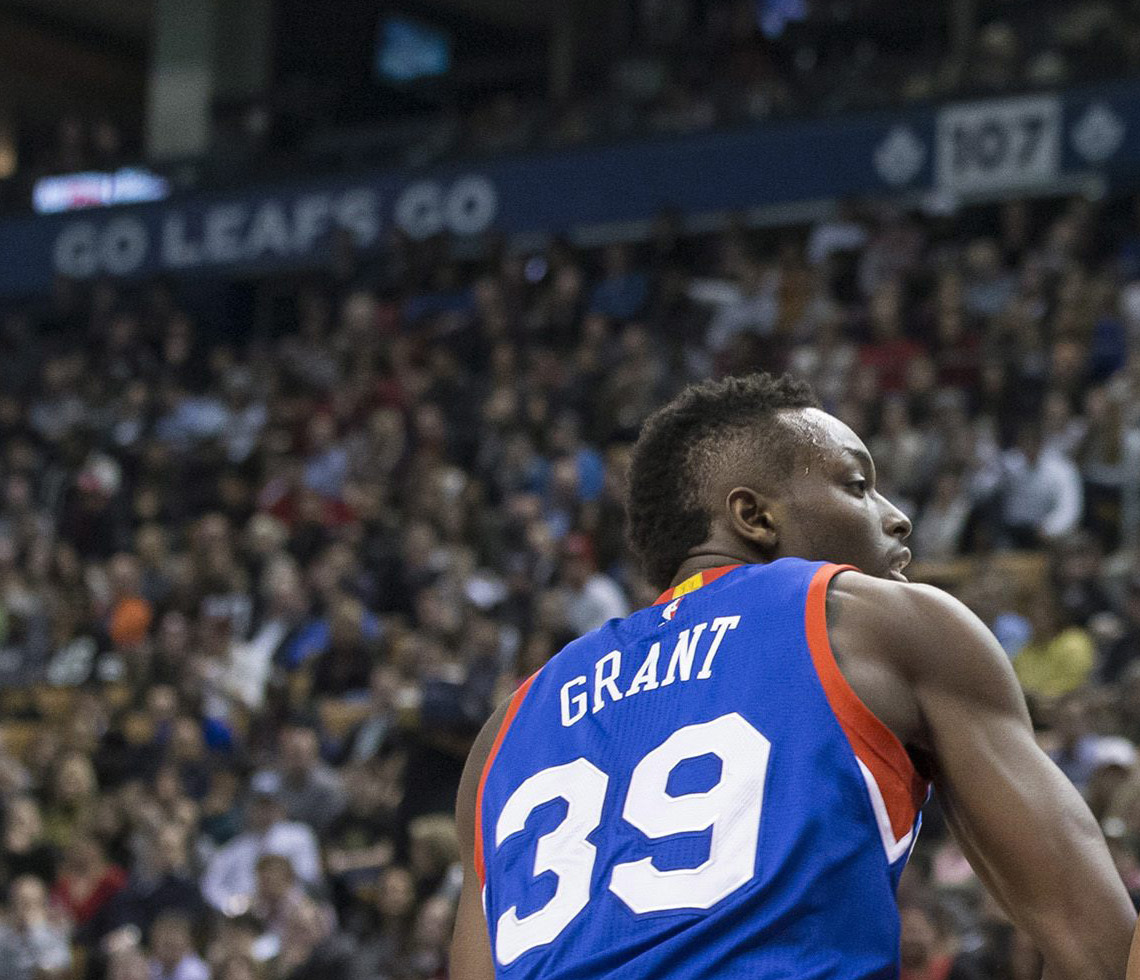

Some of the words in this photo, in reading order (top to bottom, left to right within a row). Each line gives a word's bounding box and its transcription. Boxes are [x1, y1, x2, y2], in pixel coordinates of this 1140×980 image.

[951, 117, 1043, 171] 107
[54, 216, 148, 278] GO
[396, 177, 497, 238] GO
[560, 615, 741, 727] GRANT
[495, 712, 771, 966] 39
